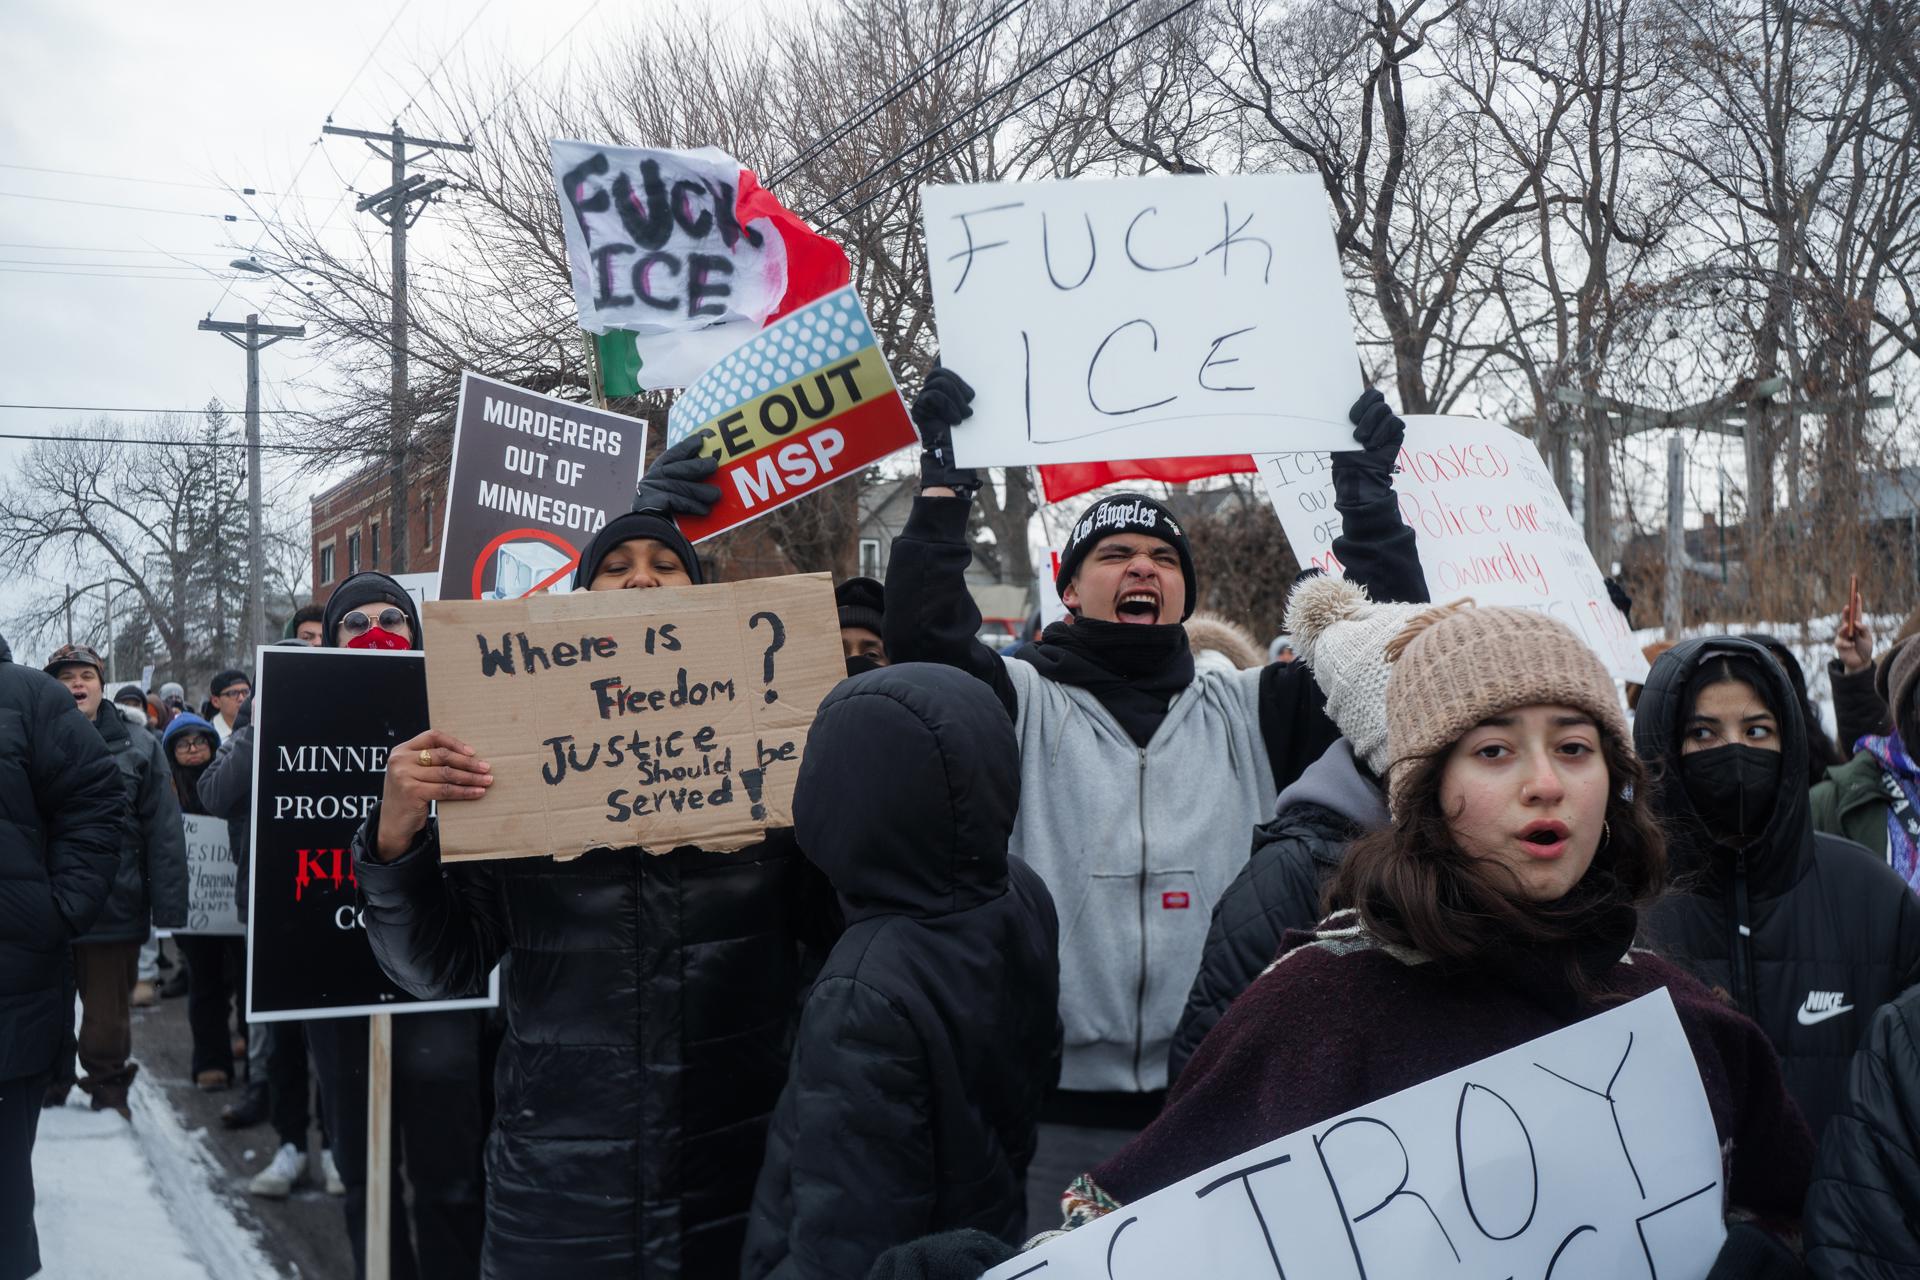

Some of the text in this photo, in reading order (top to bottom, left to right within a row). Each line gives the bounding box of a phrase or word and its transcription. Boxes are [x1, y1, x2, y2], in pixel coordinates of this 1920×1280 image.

[592, 243, 734, 317] ICE
[1021, 318, 1257, 442] ICE
[483, 396, 622, 456] MURDERERS
[698, 357, 862, 463] CE OUT
[504, 445, 586, 487] OUT OF
[730, 427, 845, 509] MSP
[478, 479, 607, 534] MINNESOTA
[1094, 500, 1159, 529] Angeles
[1437, 541, 1549, 596] owardly
[476, 632, 618, 677] Where
[590, 668, 735, 720] Freedom
[277, 745, 388, 772] MINNE
[757, 738, 799, 771] be
[274, 795, 379, 819] PROSE
[1806, 991, 1844, 1010] NIKE
[1007, 1032, 1645, 1280] TROY
